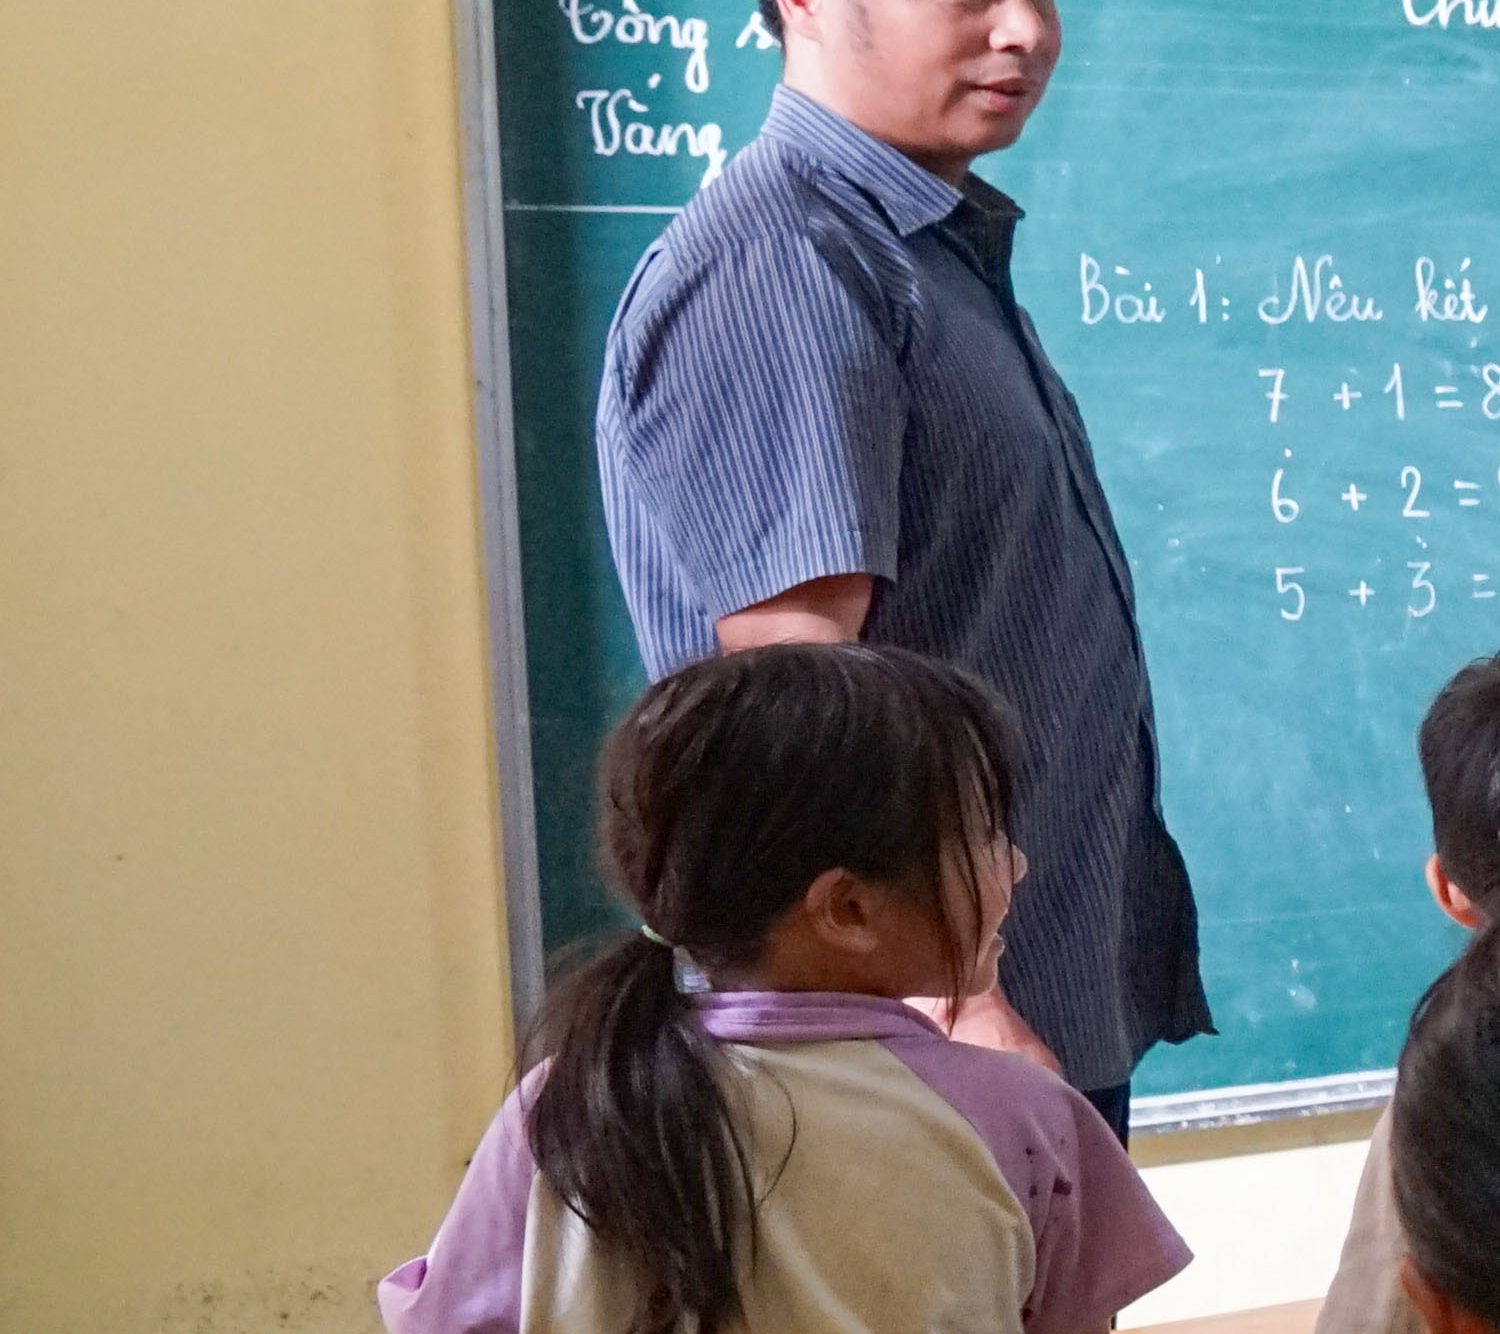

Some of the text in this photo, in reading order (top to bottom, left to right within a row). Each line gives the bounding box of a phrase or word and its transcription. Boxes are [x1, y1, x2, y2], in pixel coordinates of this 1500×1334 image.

[736, 11, 780, 50] s
[1081, 253, 1165, 324] Bài
[1190, 268, 1229, 323] 1:
[1258, 254, 1383, 324] Nêu
[1415, 257, 1488, 323] kết
[1258, 369, 1289, 422] 7
[1334, 369, 1362, 410] +
[1384, 363, 1404, 420] 1
[1435, 386, 1463, 408] =
[1272, 469, 1299, 523] 6
[1342, 484, 1367, 510] +
[1401, 466, 1430, 517] 2
[1454, 480, 1480, 506] =
